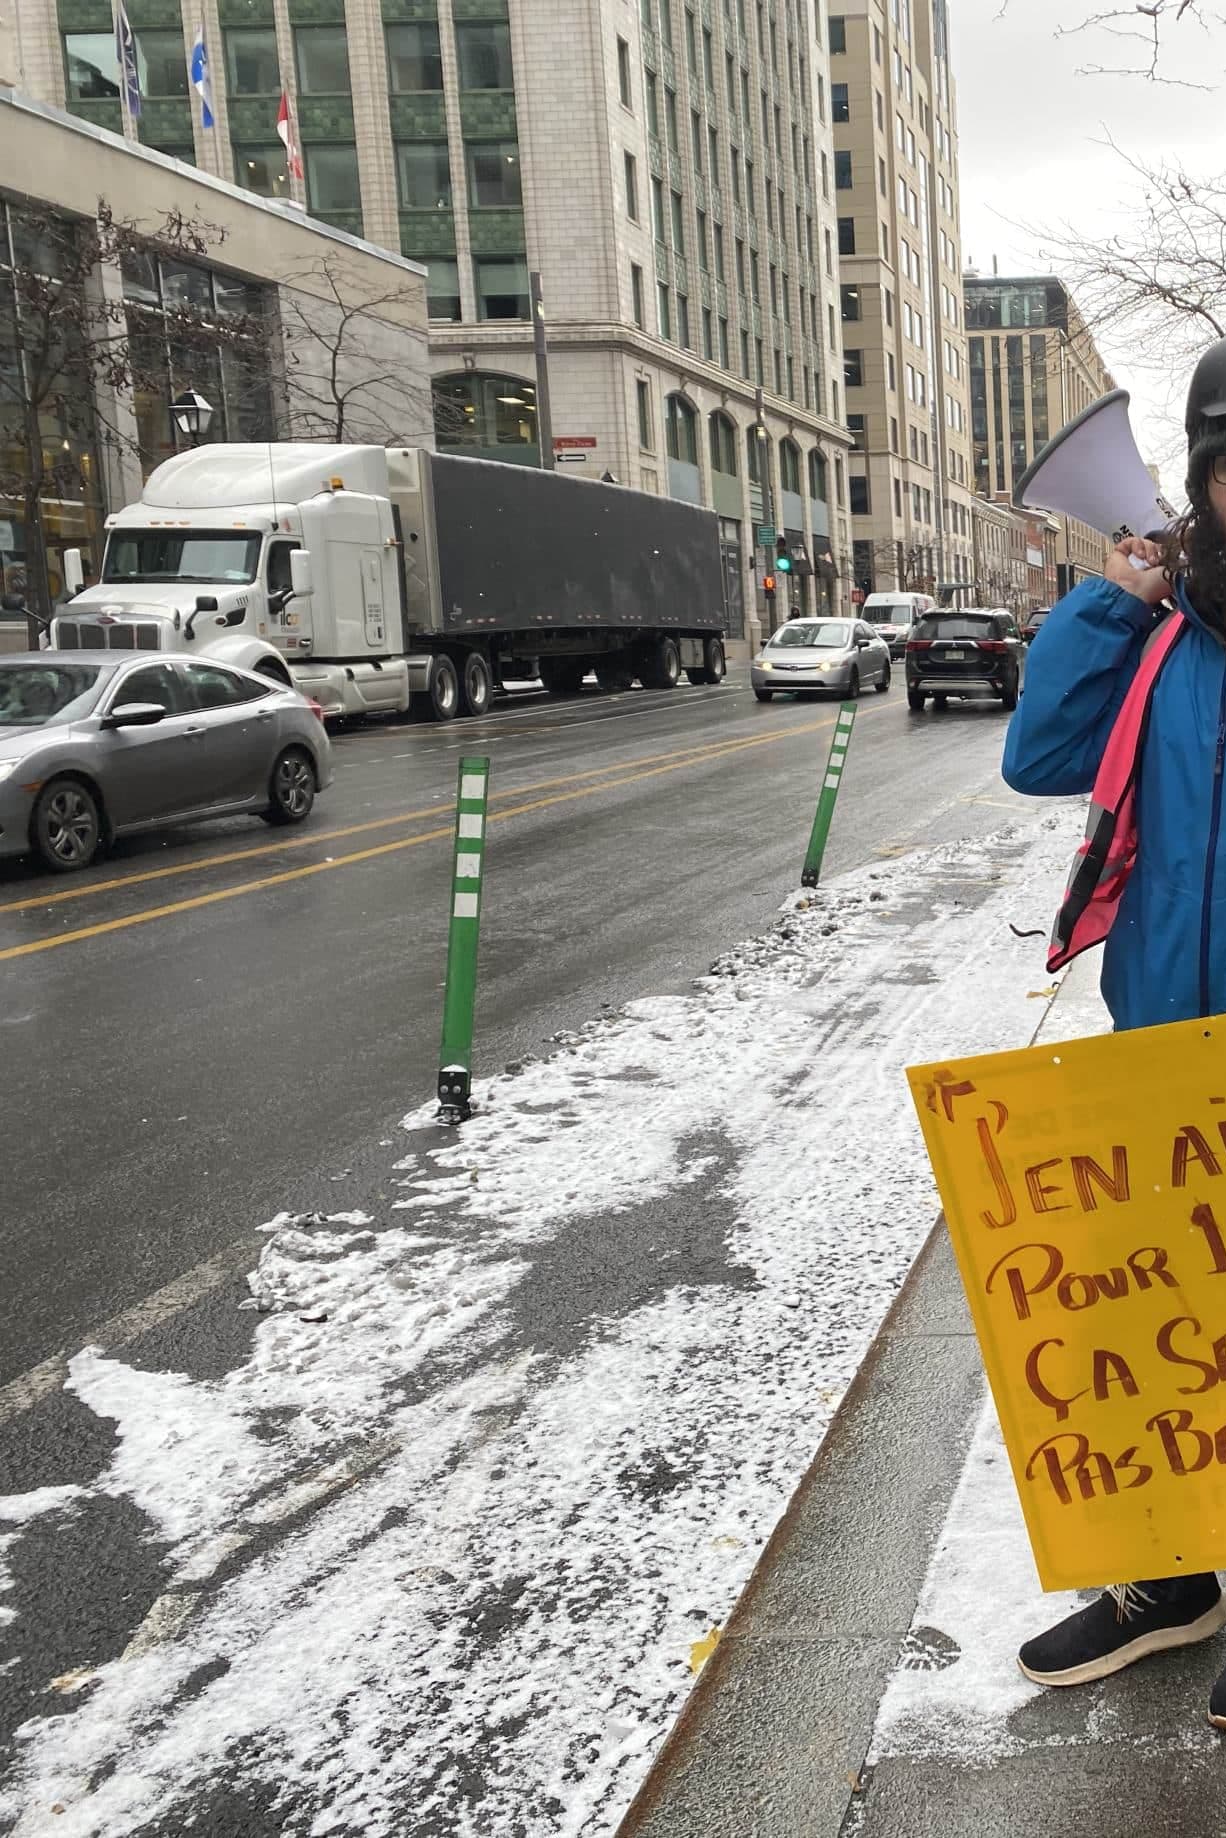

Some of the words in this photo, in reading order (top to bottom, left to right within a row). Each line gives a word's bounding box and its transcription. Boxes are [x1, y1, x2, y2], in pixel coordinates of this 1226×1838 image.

[985, 1243, 1180, 1322] POUR
[1026, 1338, 1140, 1421] ÇA
[1026, 1433, 1153, 1505] PAS
